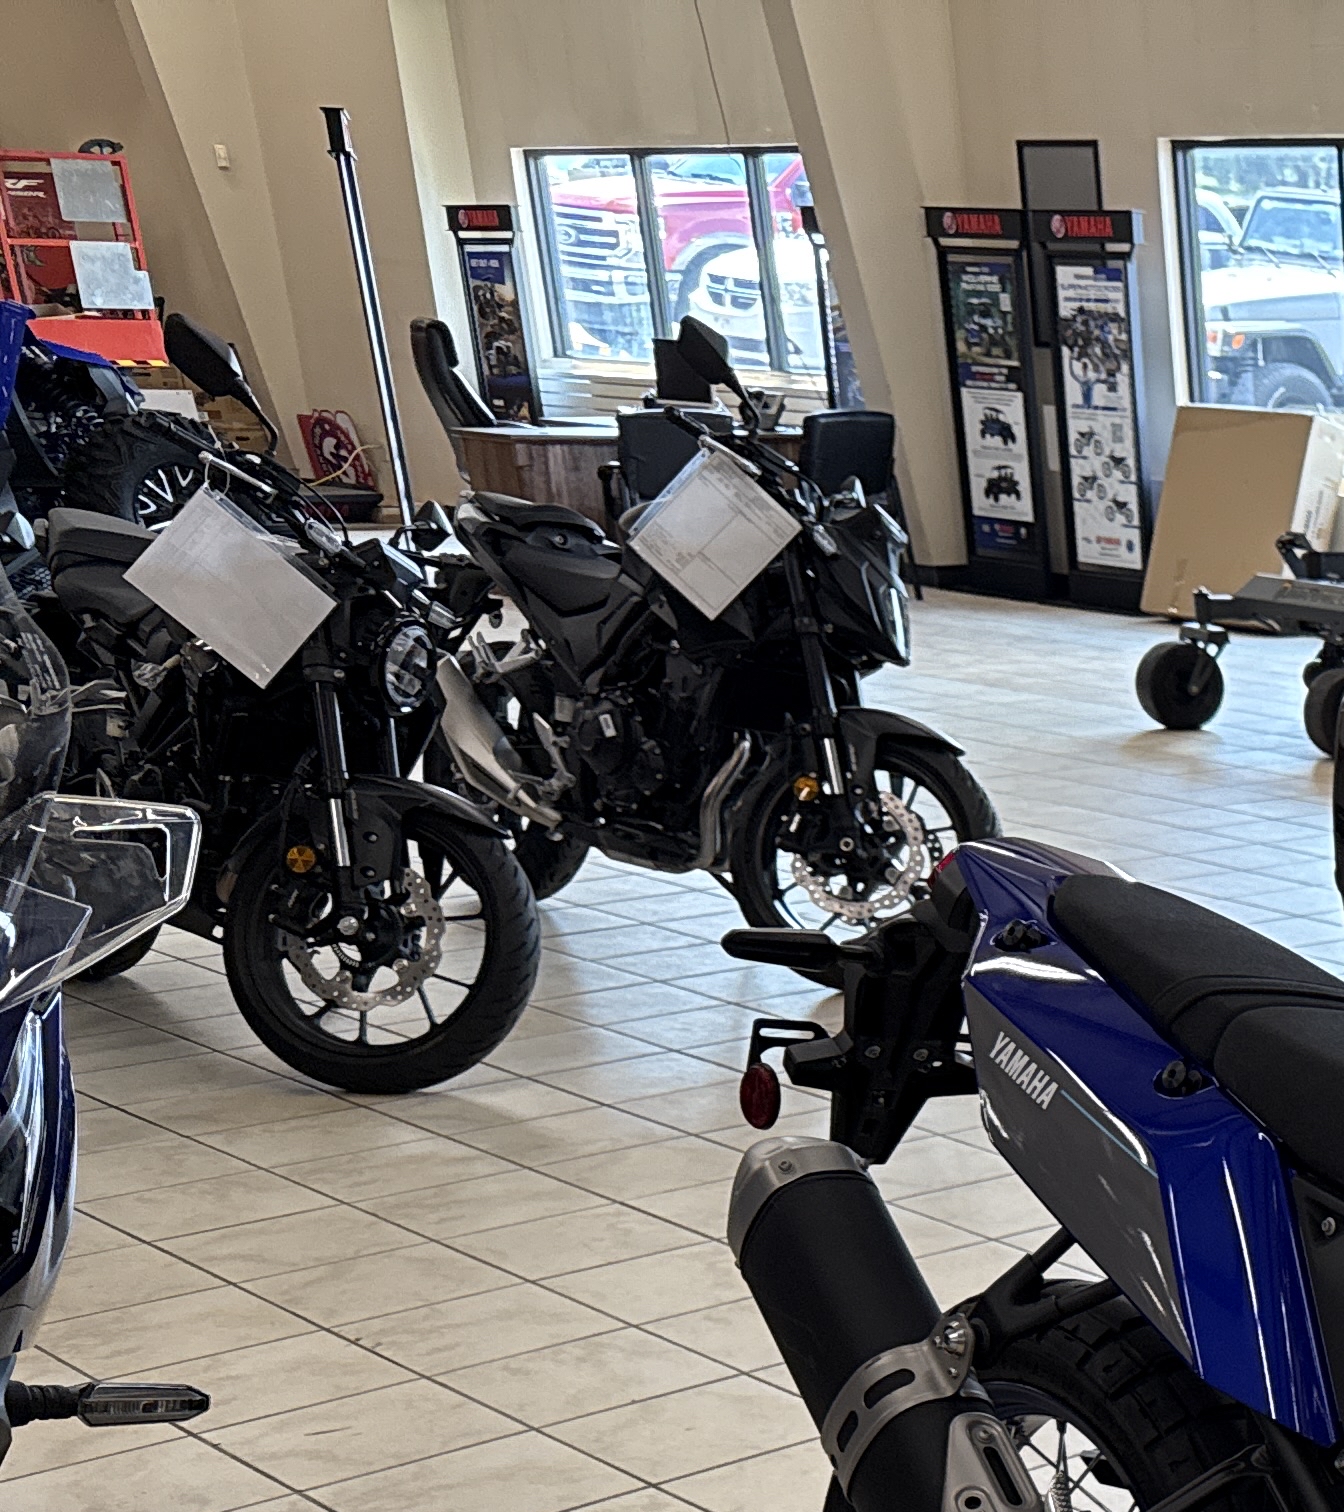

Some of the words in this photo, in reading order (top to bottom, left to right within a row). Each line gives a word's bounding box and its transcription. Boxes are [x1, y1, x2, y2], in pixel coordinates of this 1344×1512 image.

[956, 213, 1003, 235] YAMAHA
[1064, 215, 1114, 238] YAMAHA
[989, 1031, 1059, 1110] YAMAHA
